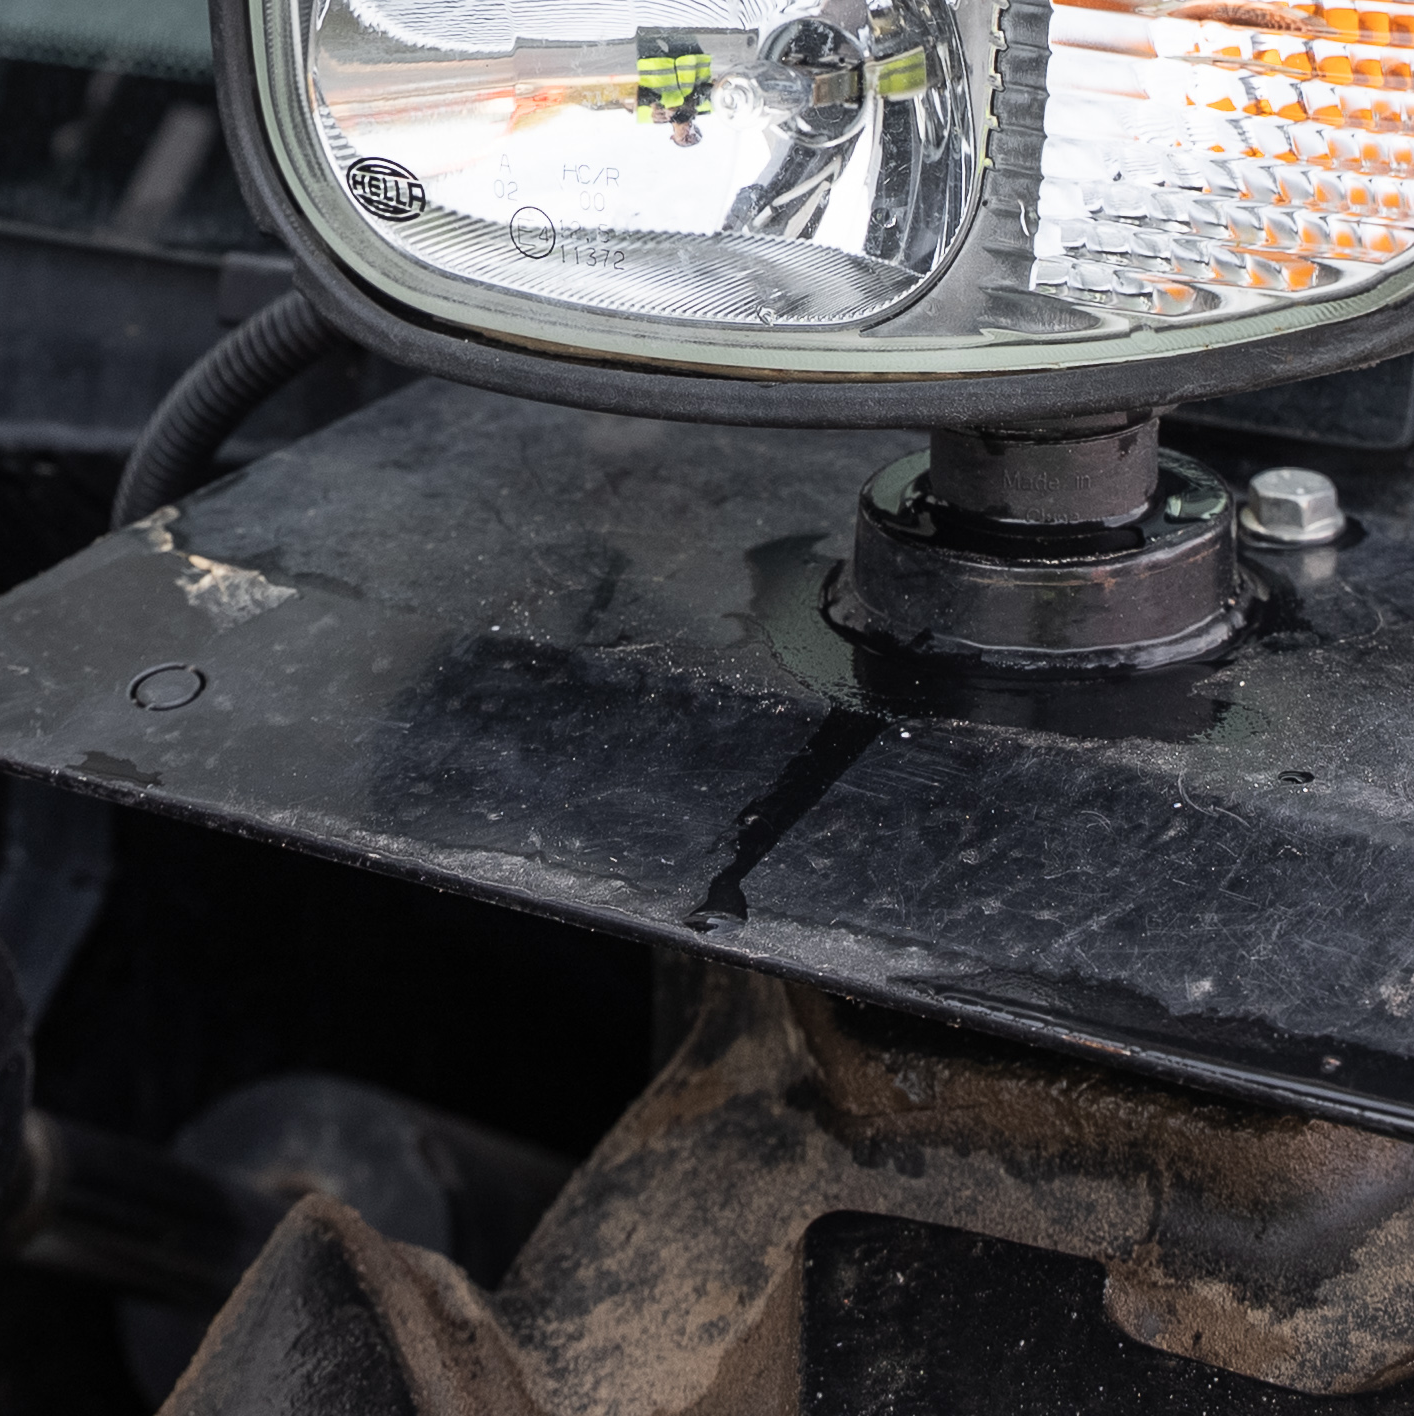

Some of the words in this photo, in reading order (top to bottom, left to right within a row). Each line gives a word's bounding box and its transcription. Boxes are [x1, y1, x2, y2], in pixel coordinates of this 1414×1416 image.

[499, 153, 513, 174] A
[561, 163, 620, 187] HC/R
[351, 172, 426, 213] HELLA
[493, 179, 518, 201] 02
[579, 190, 605, 212] 00
[517, 217, 550, 249] E4
[560, 244, 626, 271] 11372
[1002, 469, 1060, 491] Made
[1074, 472, 1092, 491] in
